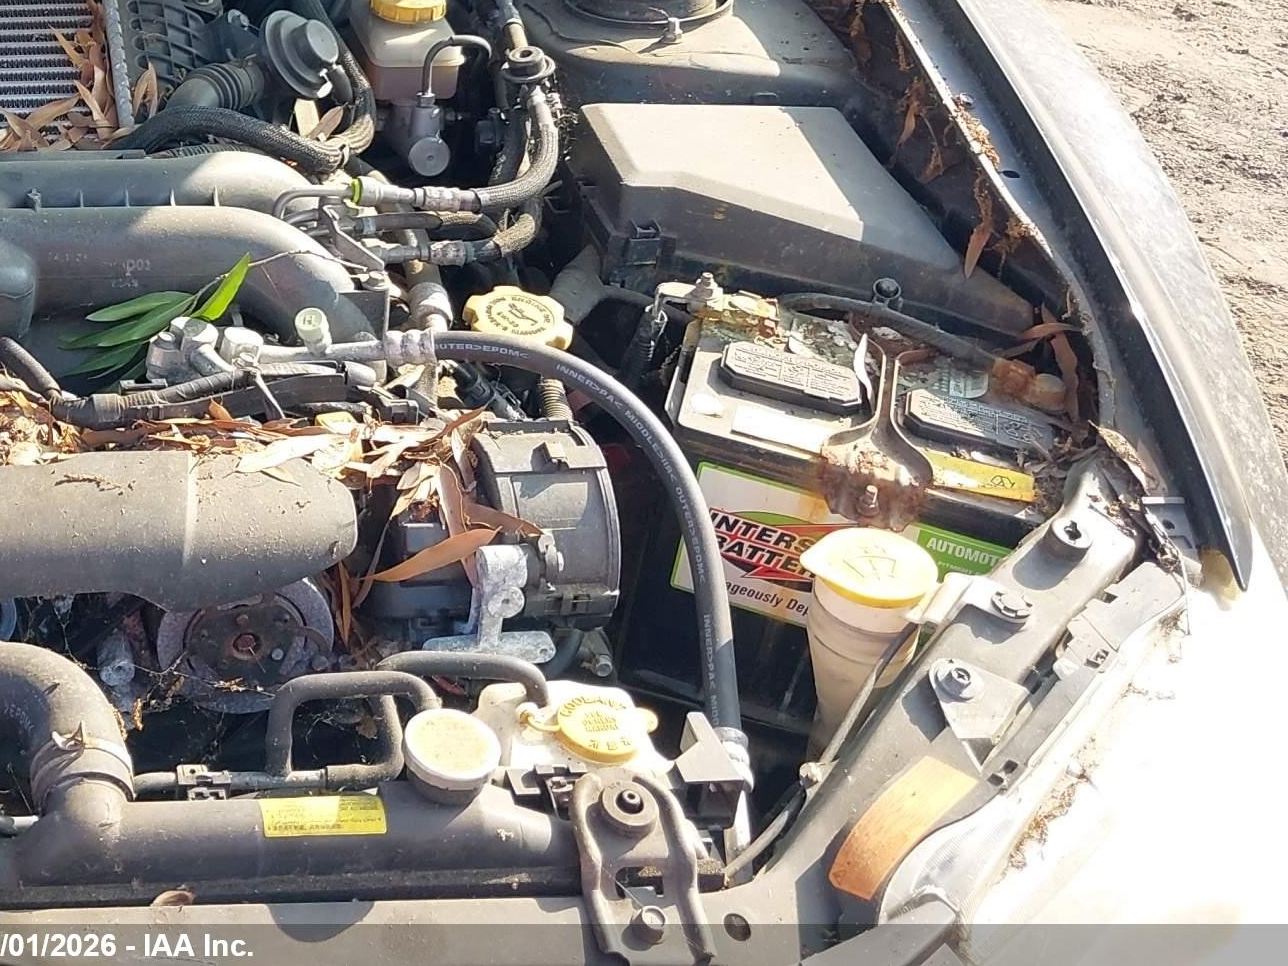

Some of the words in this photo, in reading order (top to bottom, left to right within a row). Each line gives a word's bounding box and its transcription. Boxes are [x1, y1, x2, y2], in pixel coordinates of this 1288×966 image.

[709, 512, 814, 551] INTERS
[715, 534, 816, 579] BATTE
[926, 537, 1002, 567] AUTOMOT
[725, 580, 784, 608] ageously
